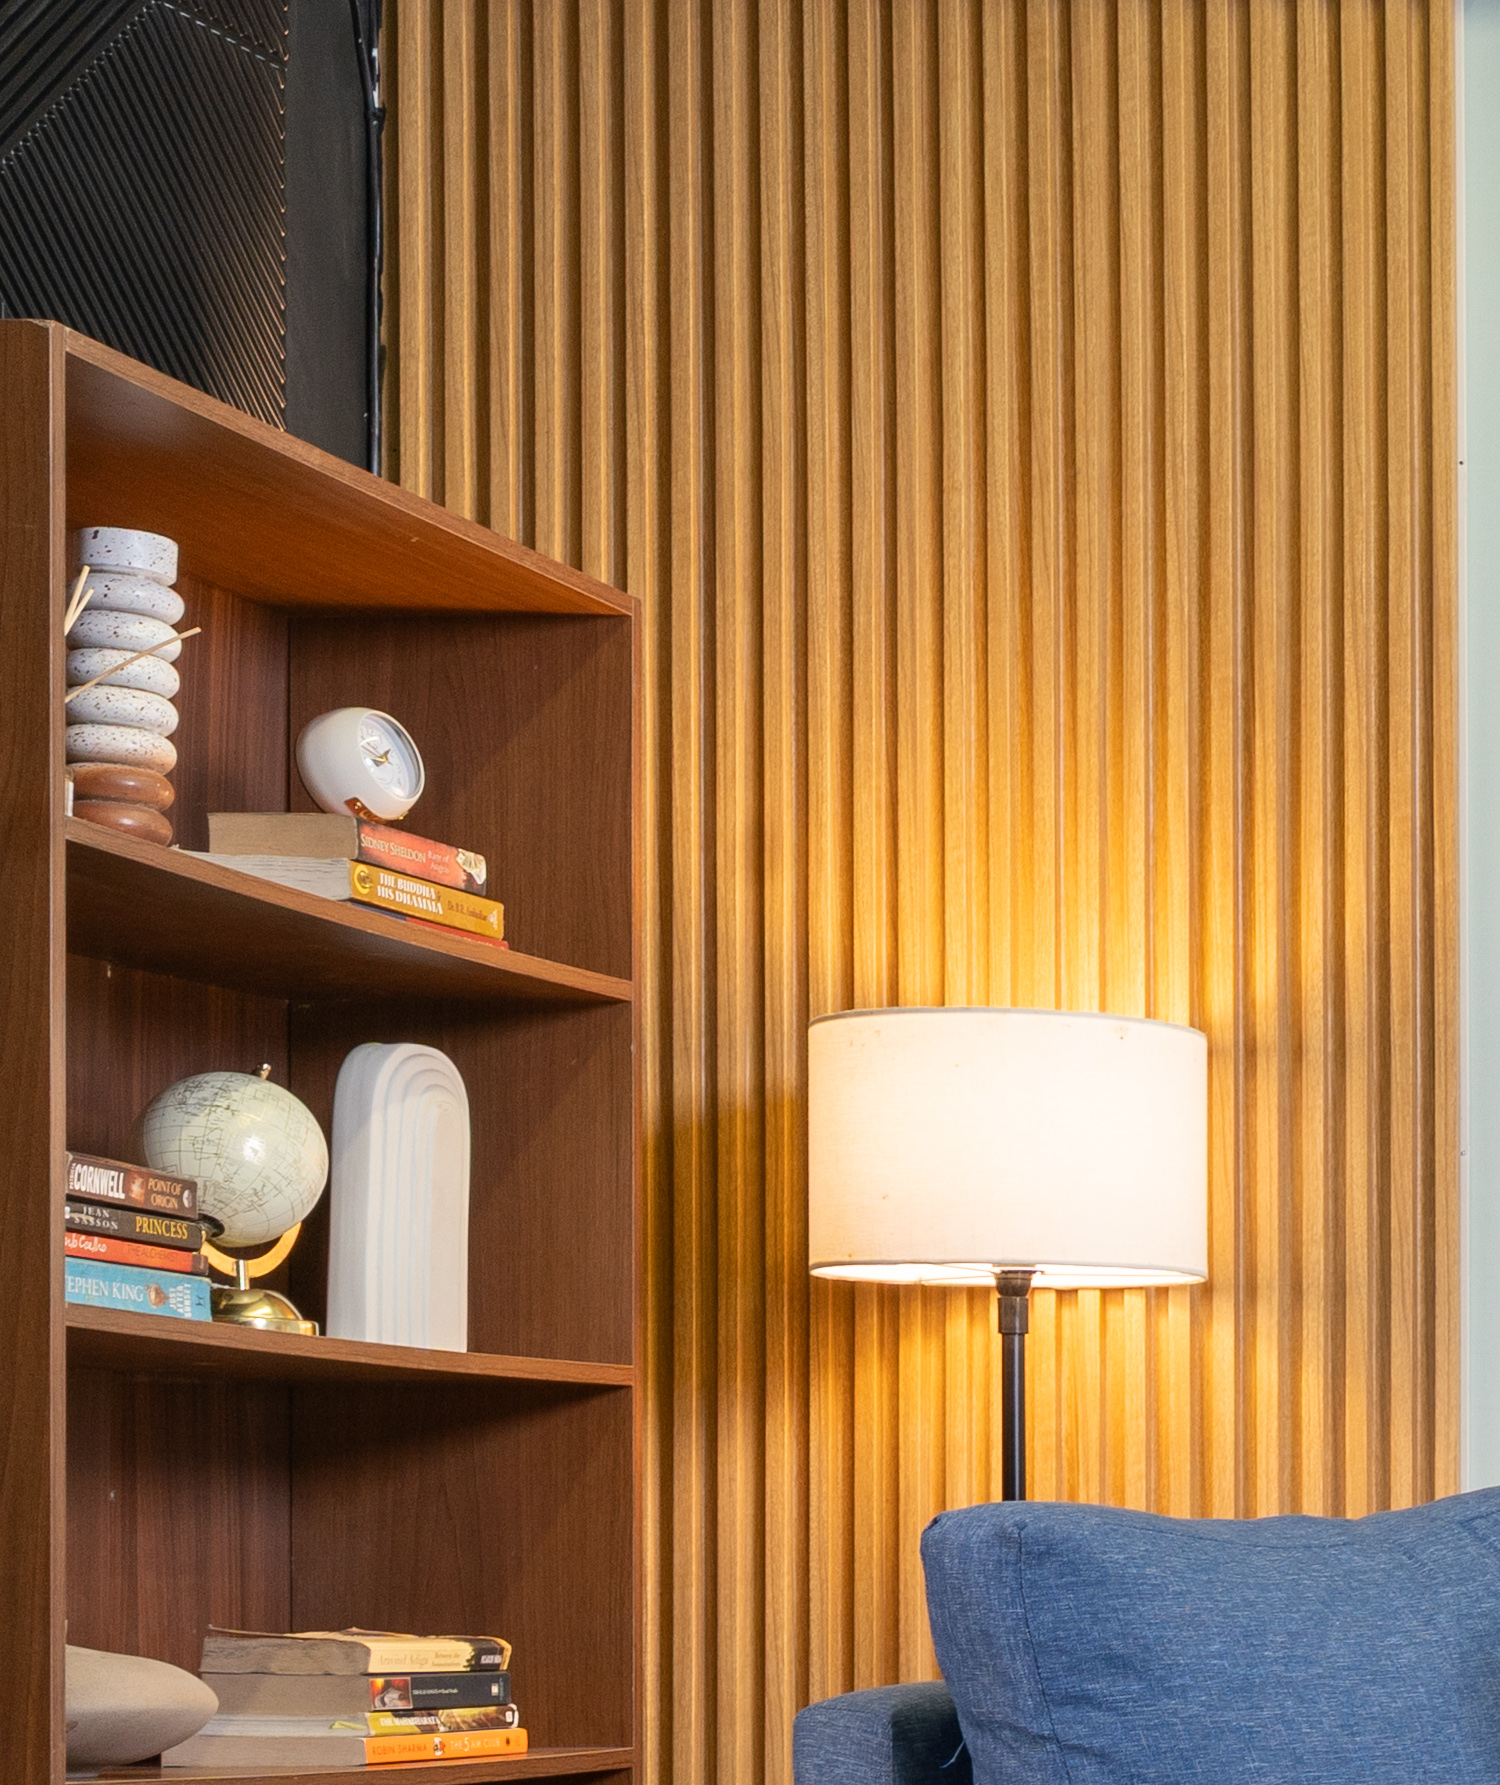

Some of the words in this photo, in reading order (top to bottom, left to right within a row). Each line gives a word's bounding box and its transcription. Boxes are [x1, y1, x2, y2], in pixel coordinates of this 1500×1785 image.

[361, 834, 389, 851] SIDNEY
[390, 842, 426, 863] SHELDON
[379, 873, 395, 887] THE
[397, 879, 436, 900] BUDDHA
[377, 886, 394, 899] HIS
[396, 891, 443, 915] DHAMMA
[74, 1163, 125, 1199] CORNWELL
[148, 1178, 170, 1192] POINT
[171, 1182, 182, 1196] OF
[83, 1206, 110, 1218] JEAN
[151, 1194, 178, 1209] ORIGIN
[74, 1216, 118, 1230] SASSON
[135, 1216, 188, 1239] PRINCESS
[65, 1275, 108, 1297] EPHEN
[112, 1282, 144, 1302] KING
[184, 1283, 192, 1318] SUNSET
[372, 1745, 395, 1756] ROBIN
[398, 1743, 427, 1754] SHARMA
[450, 1740, 462, 1750] THE
[464, 1737, 470, 1752] 5
[483, 1737, 500, 1748] CLUB
